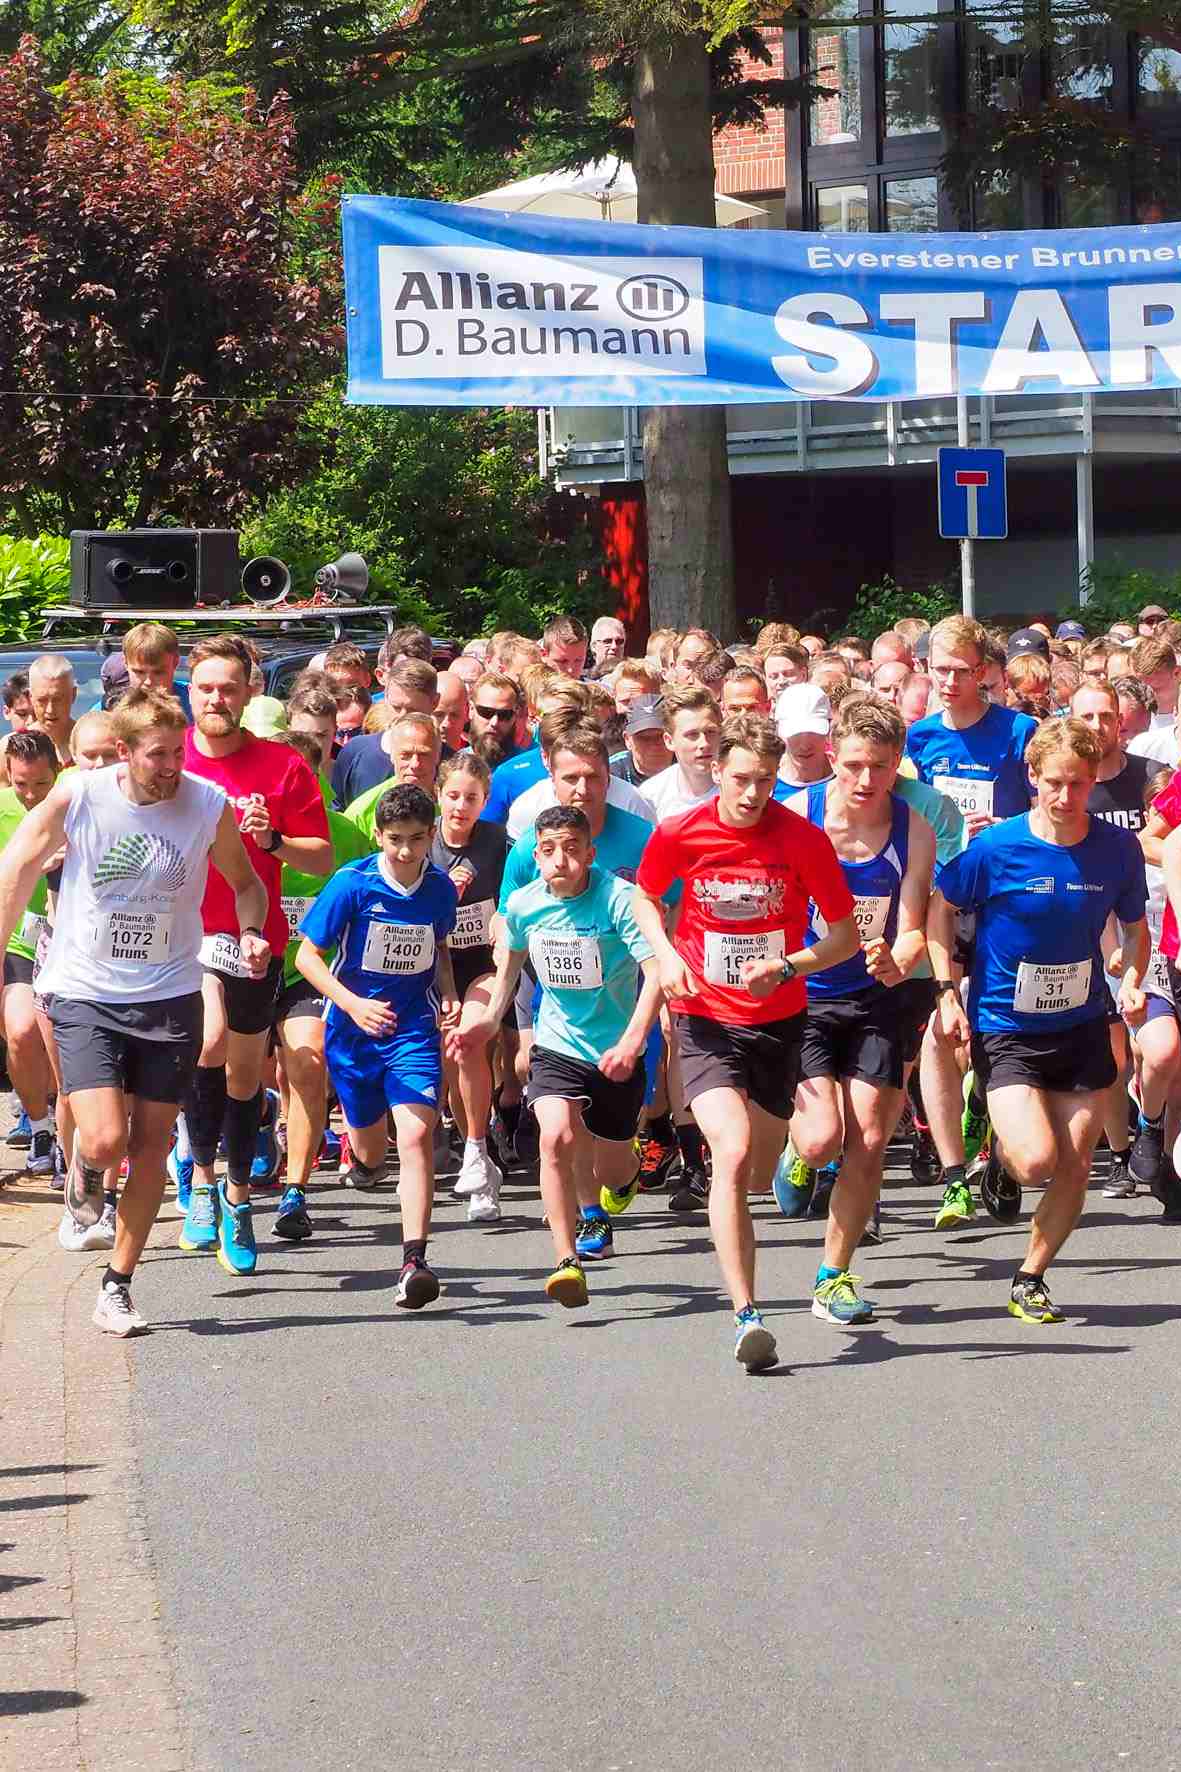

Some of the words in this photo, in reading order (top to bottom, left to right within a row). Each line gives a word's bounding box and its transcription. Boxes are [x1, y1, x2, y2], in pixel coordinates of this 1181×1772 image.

[807, 246, 1019, 269] Everstener
[394, 271, 599, 311] Allianz
[395, 319, 444, 356] D.
[457, 318, 691, 356] Baumann
[110, 912, 143, 922] Allianz
[111, 930, 153, 945] 1072
[384, 926, 413, 936] Allianz
[451, 934, 483, 946] bruns
[721, 936, 754, 946] Allianz
[111, 944, 149, 960] bruns
[383, 943, 421, 957] 1400
[211, 952, 240, 974] bruns
[382, 956, 416, 970] bruns
[544, 956, 583, 970] 1386
[723, 953, 766, 969] 16
[548, 969, 582, 984] bruns
[1034, 967, 1067, 975] Allianz
[1045, 983, 1064, 996] 31
[1035, 997, 1070, 1009] bruns
